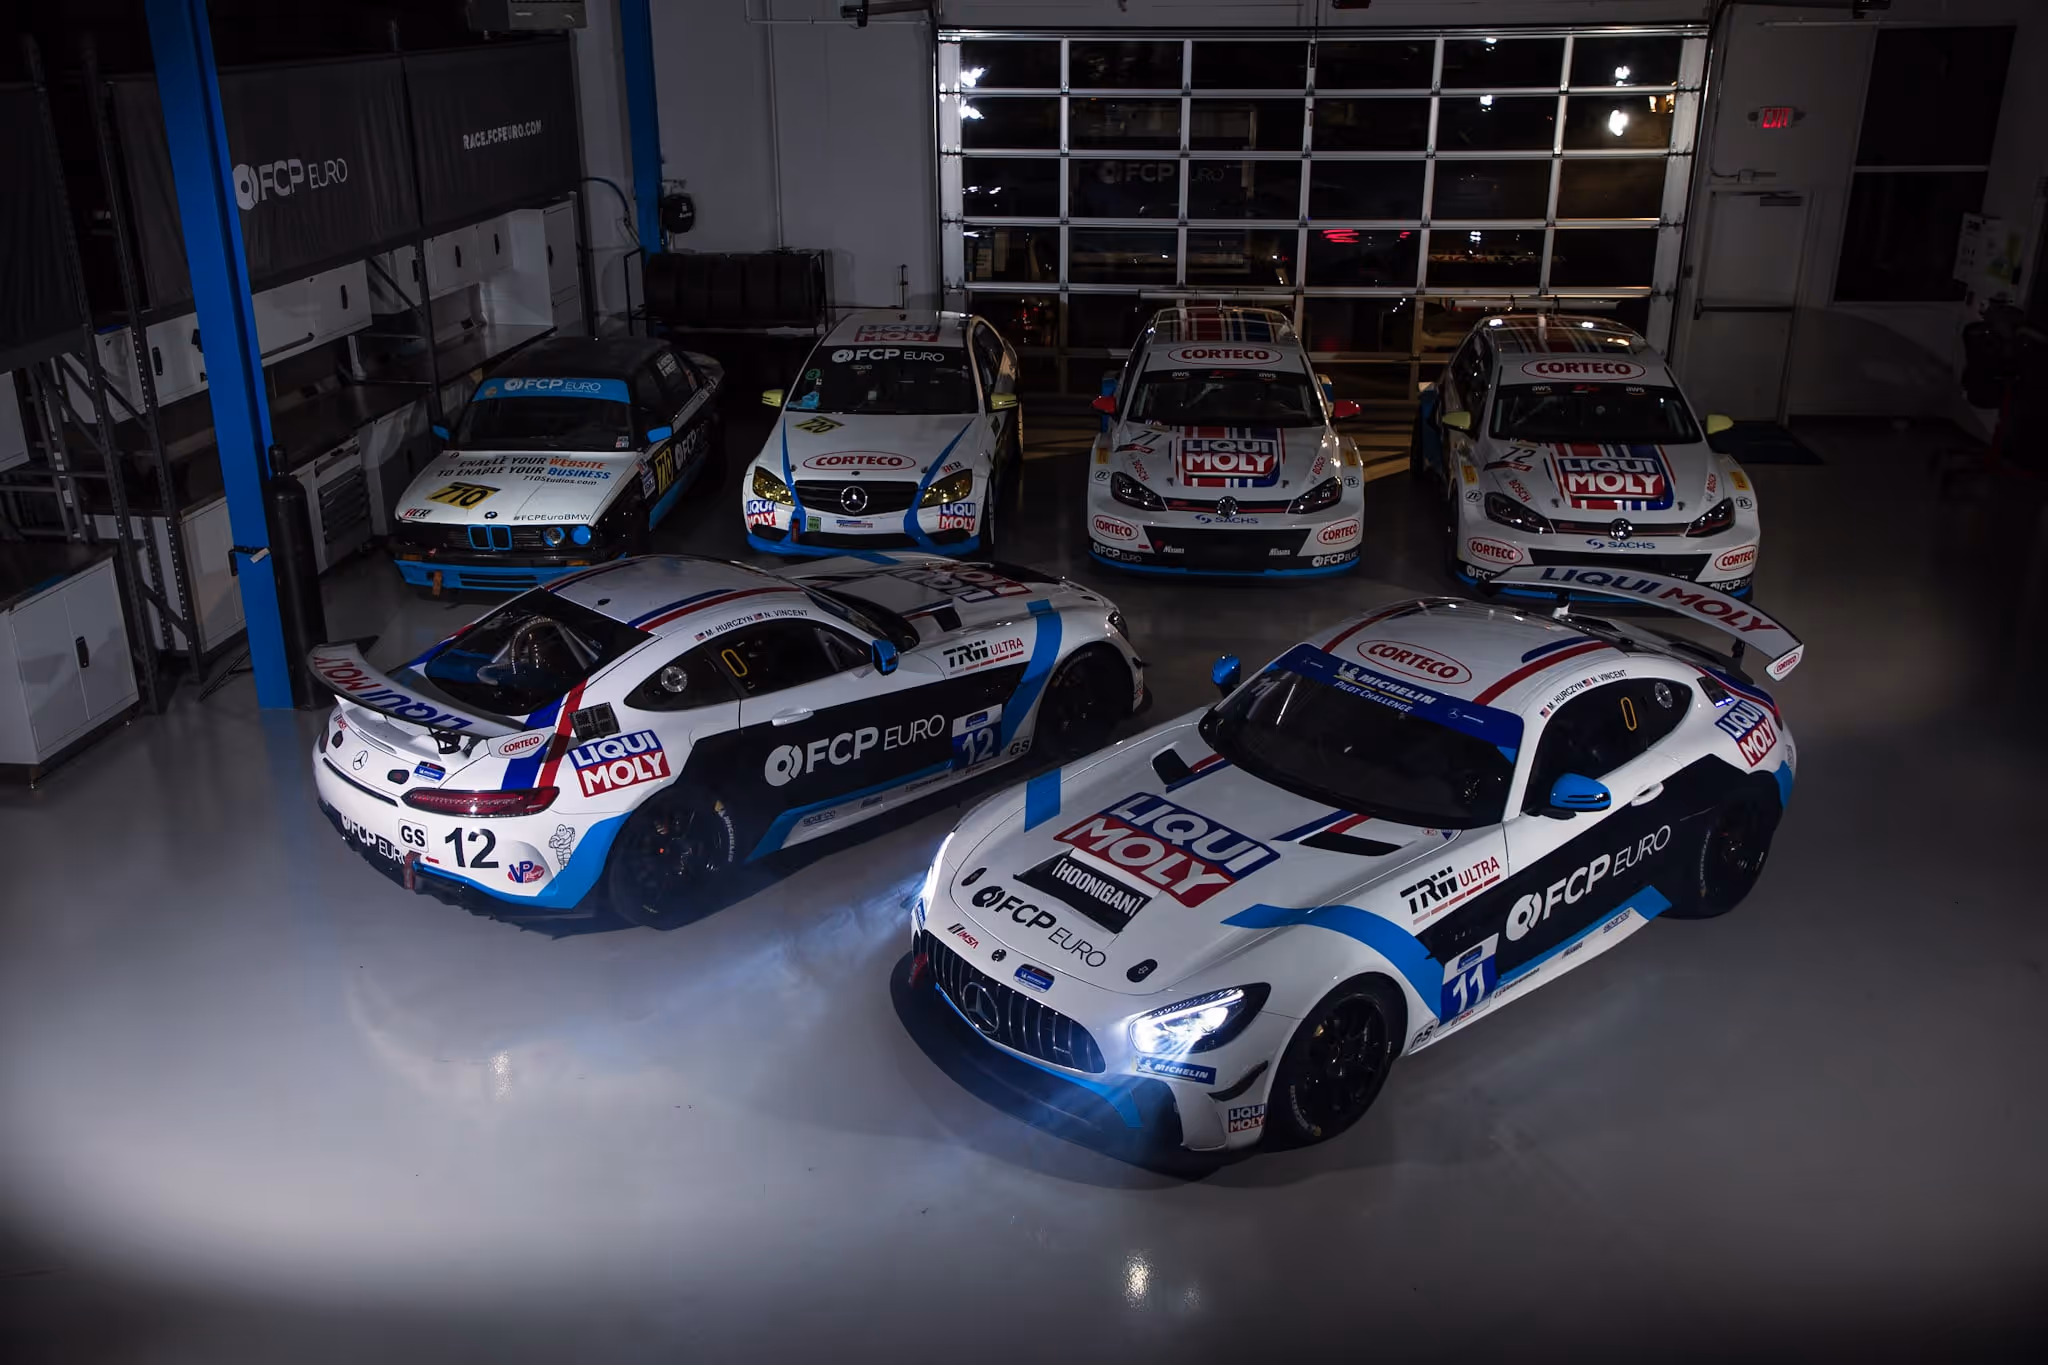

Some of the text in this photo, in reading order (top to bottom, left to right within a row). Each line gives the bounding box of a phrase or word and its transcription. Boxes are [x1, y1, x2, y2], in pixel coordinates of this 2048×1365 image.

[259, 158, 348, 201] FCP EURO
[859, 332, 936, 342] MOLY
[856, 349, 944, 362] FCP EURO
[1181, 349, 1269, 360] CORTECO
[1536, 362, 1631, 375] CORTECO
[524, 379, 601, 391] FCP EURO
[1187, 440, 1274, 453] LIQUI
[1500, 447, 1536, 463] 72
[511, 457, 547, 466] YOUR
[549, 458, 609, 469] WEBSITE
[816, 456, 902, 466] CORTECO
[1186, 453, 1272, 473] MOLY
[1560, 459, 1656, 473] LIQUI
[508, 466, 545, 475] YOUR
[548, 467, 611, 480] BUSINESS
[1508, 479, 1532, 503] BOSCH
[1568, 473, 1661, 495] MOLY
[431, 483, 488, 508] 710
[513, 513, 591, 522] #FCPEuroBMW
[942, 503, 975, 516] LIQUI
[1215, 515, 1259, 524] SACHS
[940, 516, 975, 531] MOLY
[1096, 519, 1132, 537] CORTECO
[1323, 524, 1357, 541] CORTECO
[1100, 545, 1120, 558] FCP
[1608, 541, 1656, 550] SACHS
[1323, 553, 1345, 565] FCP
[1720, 579, 1741, 591] FCP
[1540, 567, 1779, 633] LIQUI MOLY
[717, 615, 754, 633] HURCZYN
[774, 610, 808, 618] VINCENT
[943, 637, 1024, 668] TRW ULTRA
[1368, 643, 1459, 679] CORTECO
[1776, 654, 1798, 674] CORTECO
[1600, 669, 1627, 682] VINCENT
[313, 656, 473, 730] LIQUI MOLY
[1334, 680, 1414, 713] PILOT CHALLENGE
[1358, 673, 1437, 705] MICHELIN
[1555, 681, 1584, 704] HURCZYN
[1718, 701, 1763, 739] LIQUI
[504, 736, 540, 753] CORTECO
[572, 731, 658, 767] LIQUI
[806, 714, 945, 774] FCP EURO
[962, 728, 994, 765] 12
[1009, 739, 1029, 756] GS
[1740, 718, 1775, 764] MOLY
[581, 751, 663, 795] MOLY
[352, 823, 377, 847] FCP
[401, 825, 426, 847] GS
[1108, 795, 1270, 874] LIQUI
[445, 827, 499, 869] 12
[1062, 817, 1231, 896] MOLY
[509, 860, 534, 884] VP
[1543, 853, 1611, 921] FCP
[1613, 824, 1671, 877] EURO
[1400, 856, 1500, 915] TRW ULTRA
[957, 930, 980, 950] IMSA
[994, 894, 1107, 968] FCP EURO
[1453, 962, 1486, 1014] 11
[1154, 1064, 1209, 1079] MICHELIN
[1230, 1105, 1265, 1121] LIQUI
[1230, 1115, 1265, 1132] MOLY
